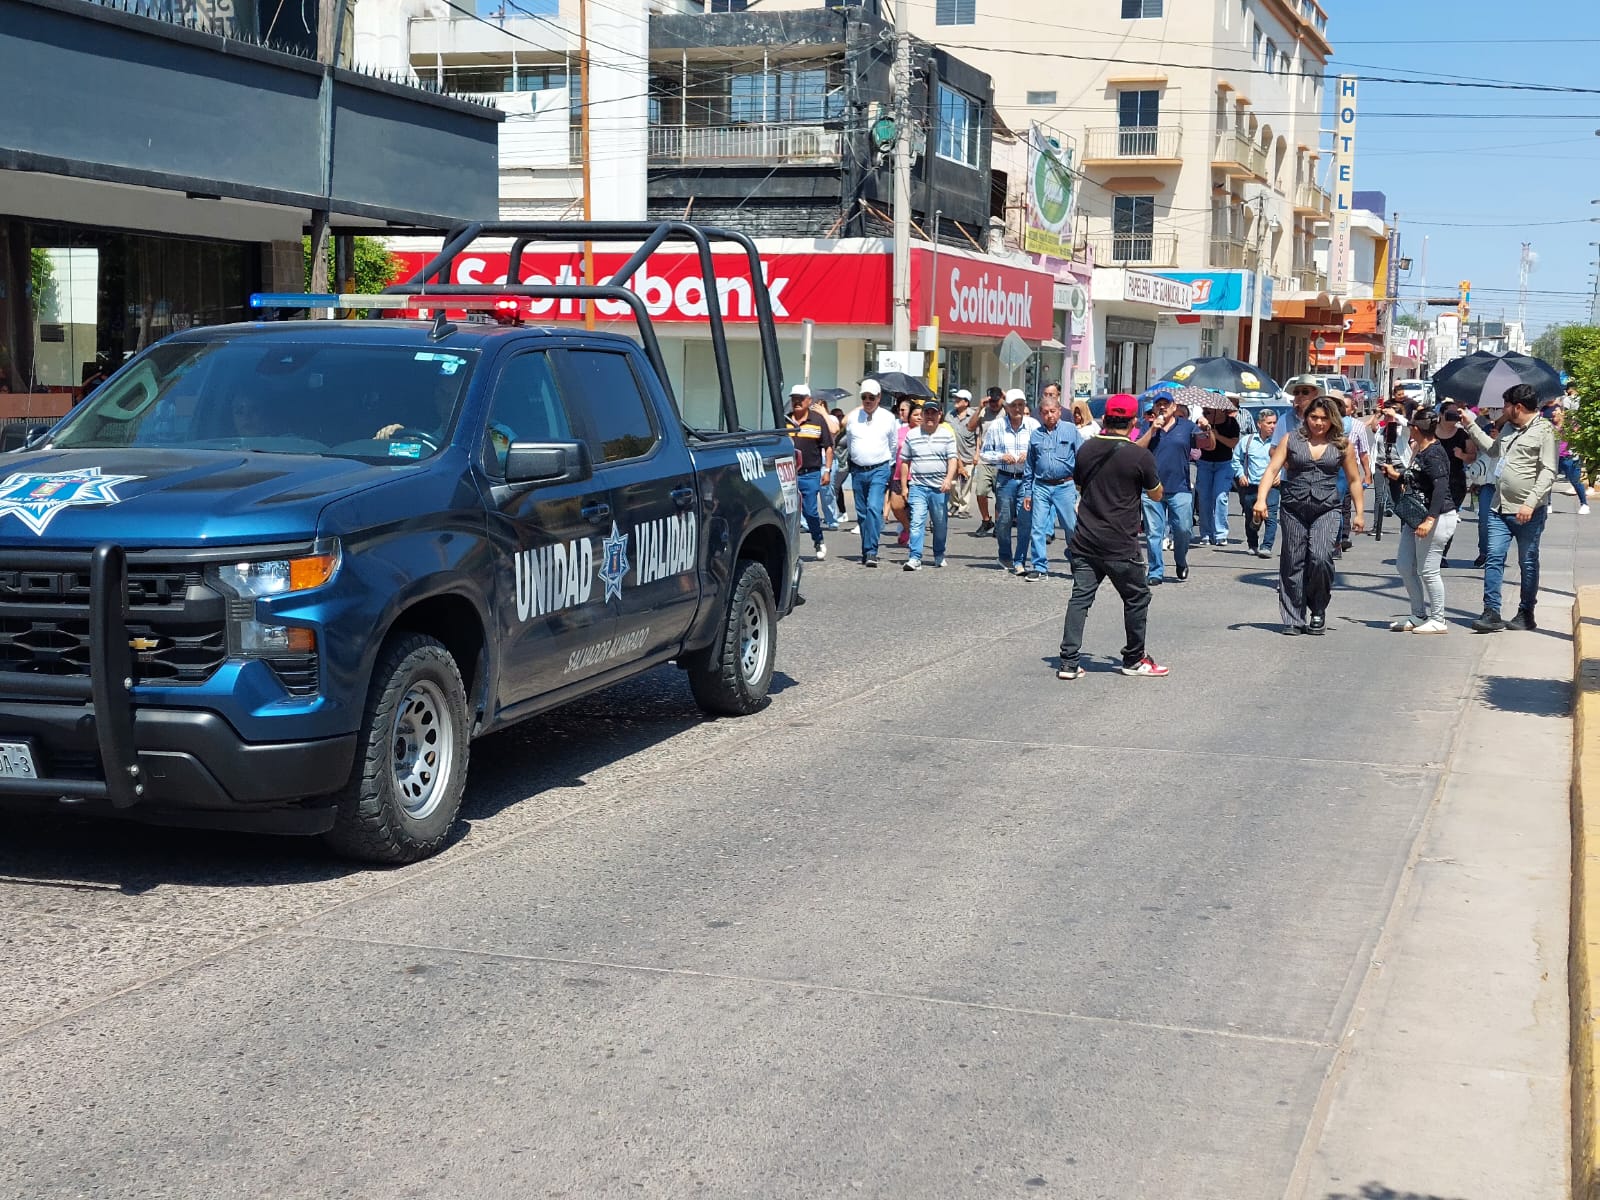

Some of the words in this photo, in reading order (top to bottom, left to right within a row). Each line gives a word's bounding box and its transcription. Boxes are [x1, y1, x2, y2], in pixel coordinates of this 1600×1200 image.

[1338, 80, 1355, 210] HOTEL
[949, 267, 1033, 329] Scotiabank
[515, 537, 593, 622] UNIDAD
[635, 511, 696, 586] VIALIDAD
[563, 639, 613, 674] SALVADOR
[607, 626, 650, 658] ALVARADO
